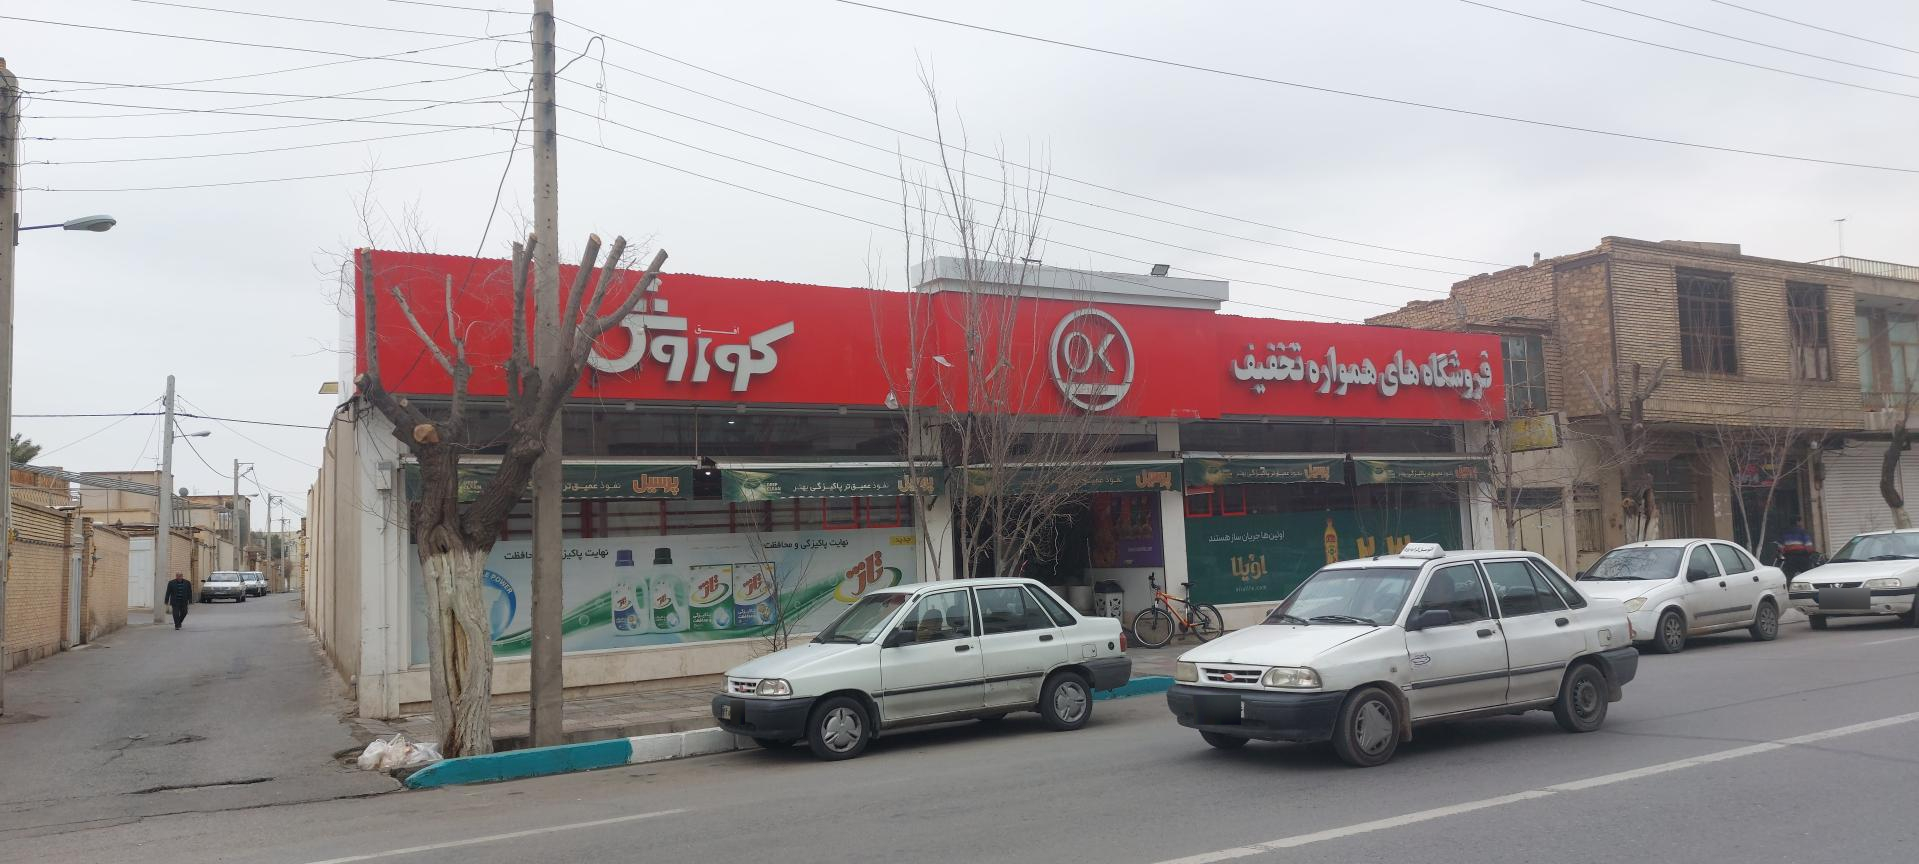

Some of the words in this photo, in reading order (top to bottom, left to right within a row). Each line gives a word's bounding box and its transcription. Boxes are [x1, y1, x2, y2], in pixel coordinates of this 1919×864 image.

[586, 277, 795, 392] کوروش
[1064, 331, 1116, 374] OK
[1233, 341, 1305, 394] تخفیف
[1307, 345, 1378, 396] همواره
[1378, 349, 1420, 397] های
[1420, 349, 1493, 400] فروشگاه
[632, 473, 681, 495] پرسیل
[810, 480, 843, 492] پاکیزگی
[763, 541, 793, 550] محافظت
[800, 538, 828, 550] پاکیزگی
[829, 537, 849, 548] نهایت
[1208, 534, 1231, 544] هستند
[503, 550, 533, 560] حافظت
[562, 548, 583, 560] پاکیز
[584, 548, 609, 560] نهایت
[491, 573, 513, 595] POWER
